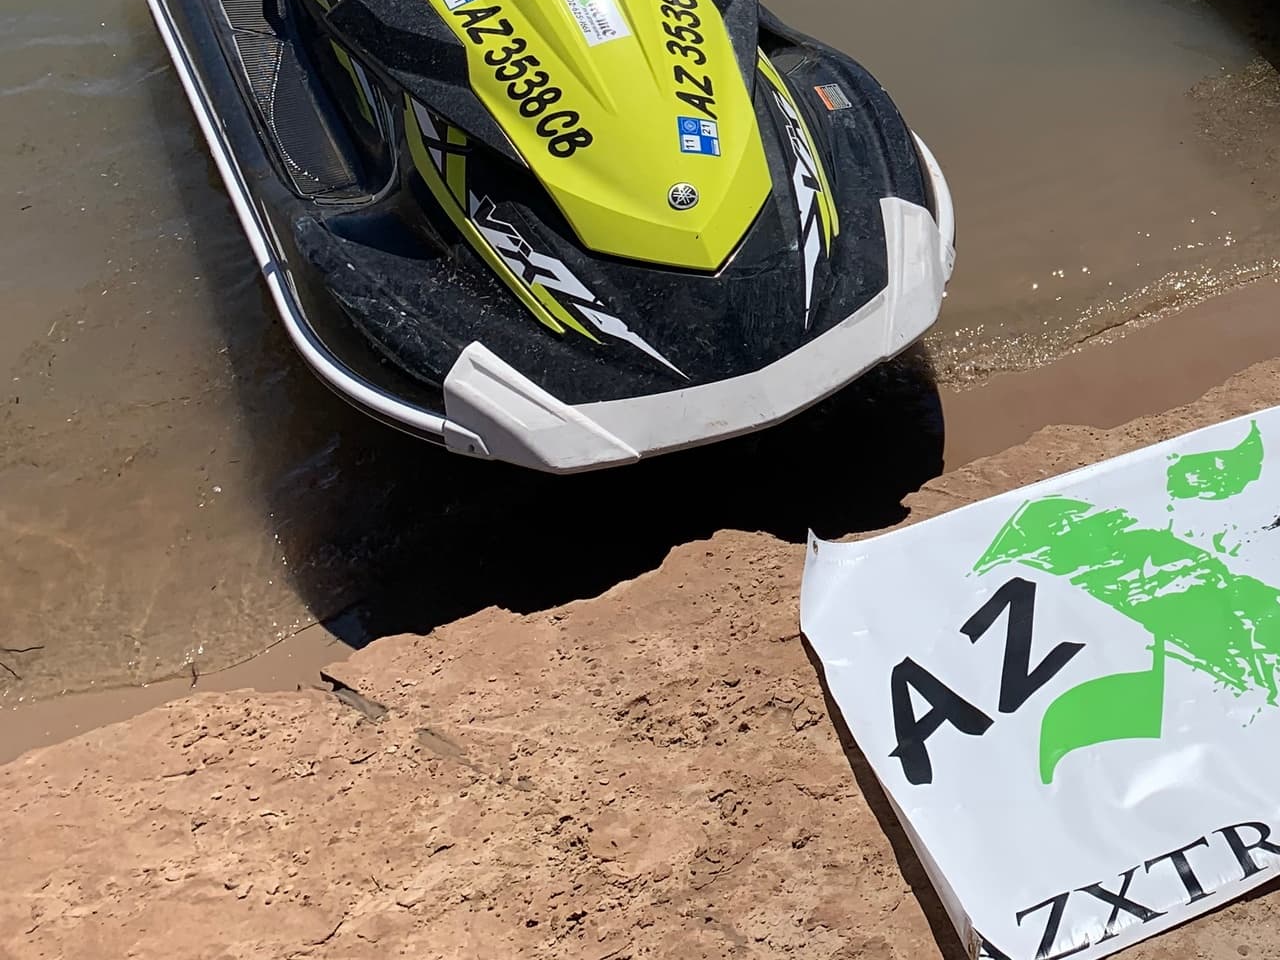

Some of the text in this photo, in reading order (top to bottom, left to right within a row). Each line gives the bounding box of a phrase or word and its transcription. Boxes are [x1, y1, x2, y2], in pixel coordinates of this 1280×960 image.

[453, 5, 594, 158] AZ 3538 CB
[674, 65, 718, 120] AZ
[685, 139, 697, 150] 11
[700, 123, 712, 136] 21
[888, 577, 1087, 786] AZ
